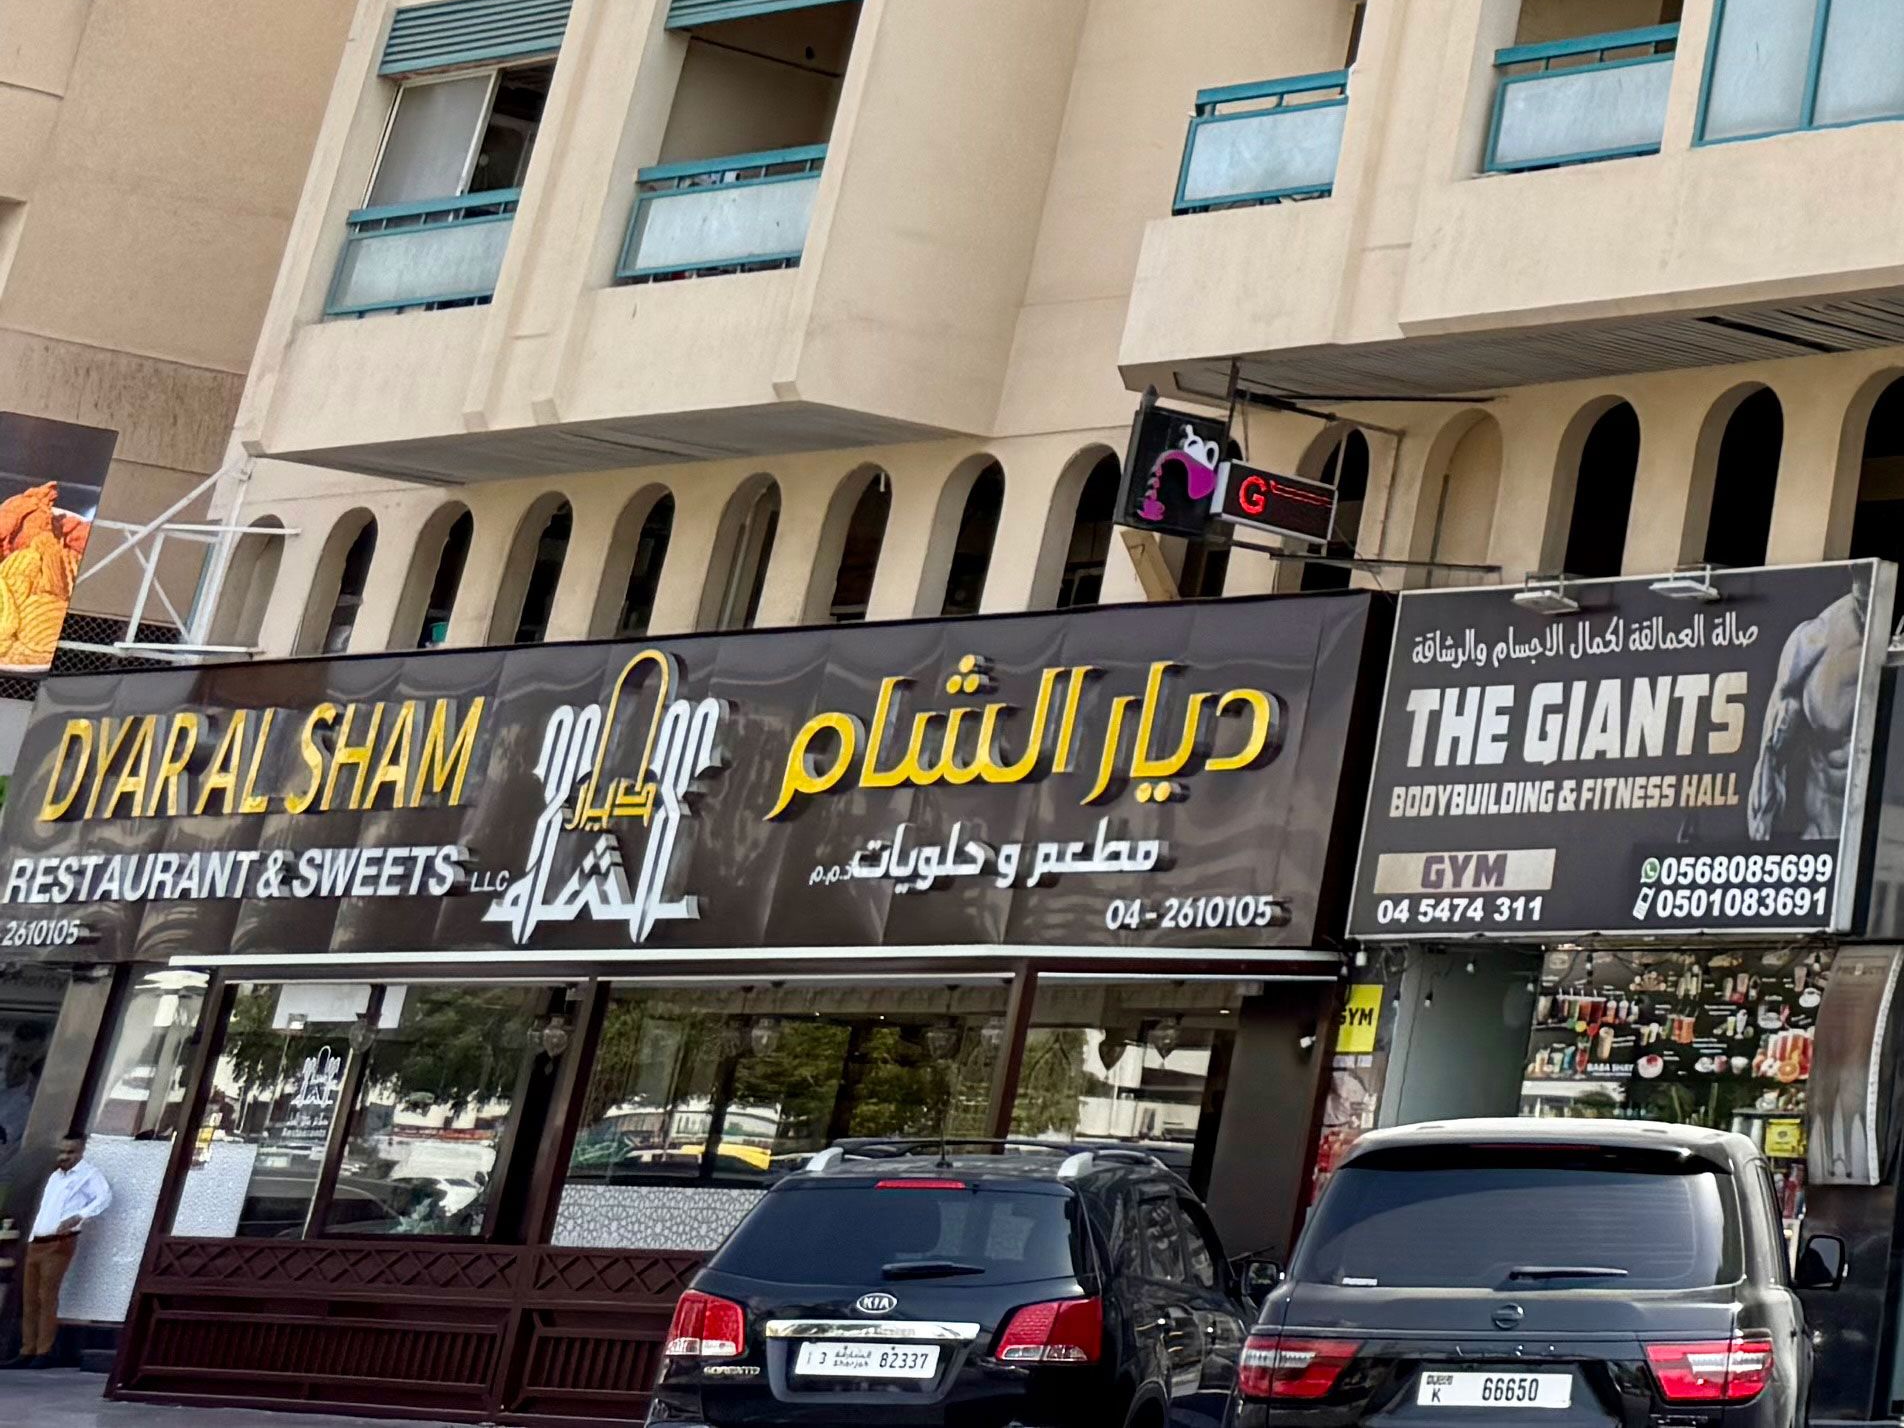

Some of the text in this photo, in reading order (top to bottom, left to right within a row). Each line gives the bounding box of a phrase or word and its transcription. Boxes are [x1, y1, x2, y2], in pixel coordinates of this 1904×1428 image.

[1412, 611, 1759, 669] صالة العمالقة لكمال الاجسام والرشاقة
[764, 654, 1280, 821] ديار الشام
[1406, 671, 1748, 767] THE GIANTS
[37, 695, 486, 822] DYAR AL SHAM
[1389, 772, 1740, 818] BODYBUILDING & FITNESS HALL
[0, 845, 510, 906] RESTAURANT & SWEETS LLC
[850, 821, 987, 894] حلويات
[997, 839, 1018, 888] و
[1027, 816, 1159, 886] مطعم
[1421, 853, 1508, 890] GYM
[1661, 854, 1833, 885] 0568085699
[1377, 896, 1543, 924] 04 5474 311
[1656, 887, 1826, 918] 0501083691
[863, 1296, 891, 1310] KIA
[1431, 1377, 1540, 1403] K 66650
